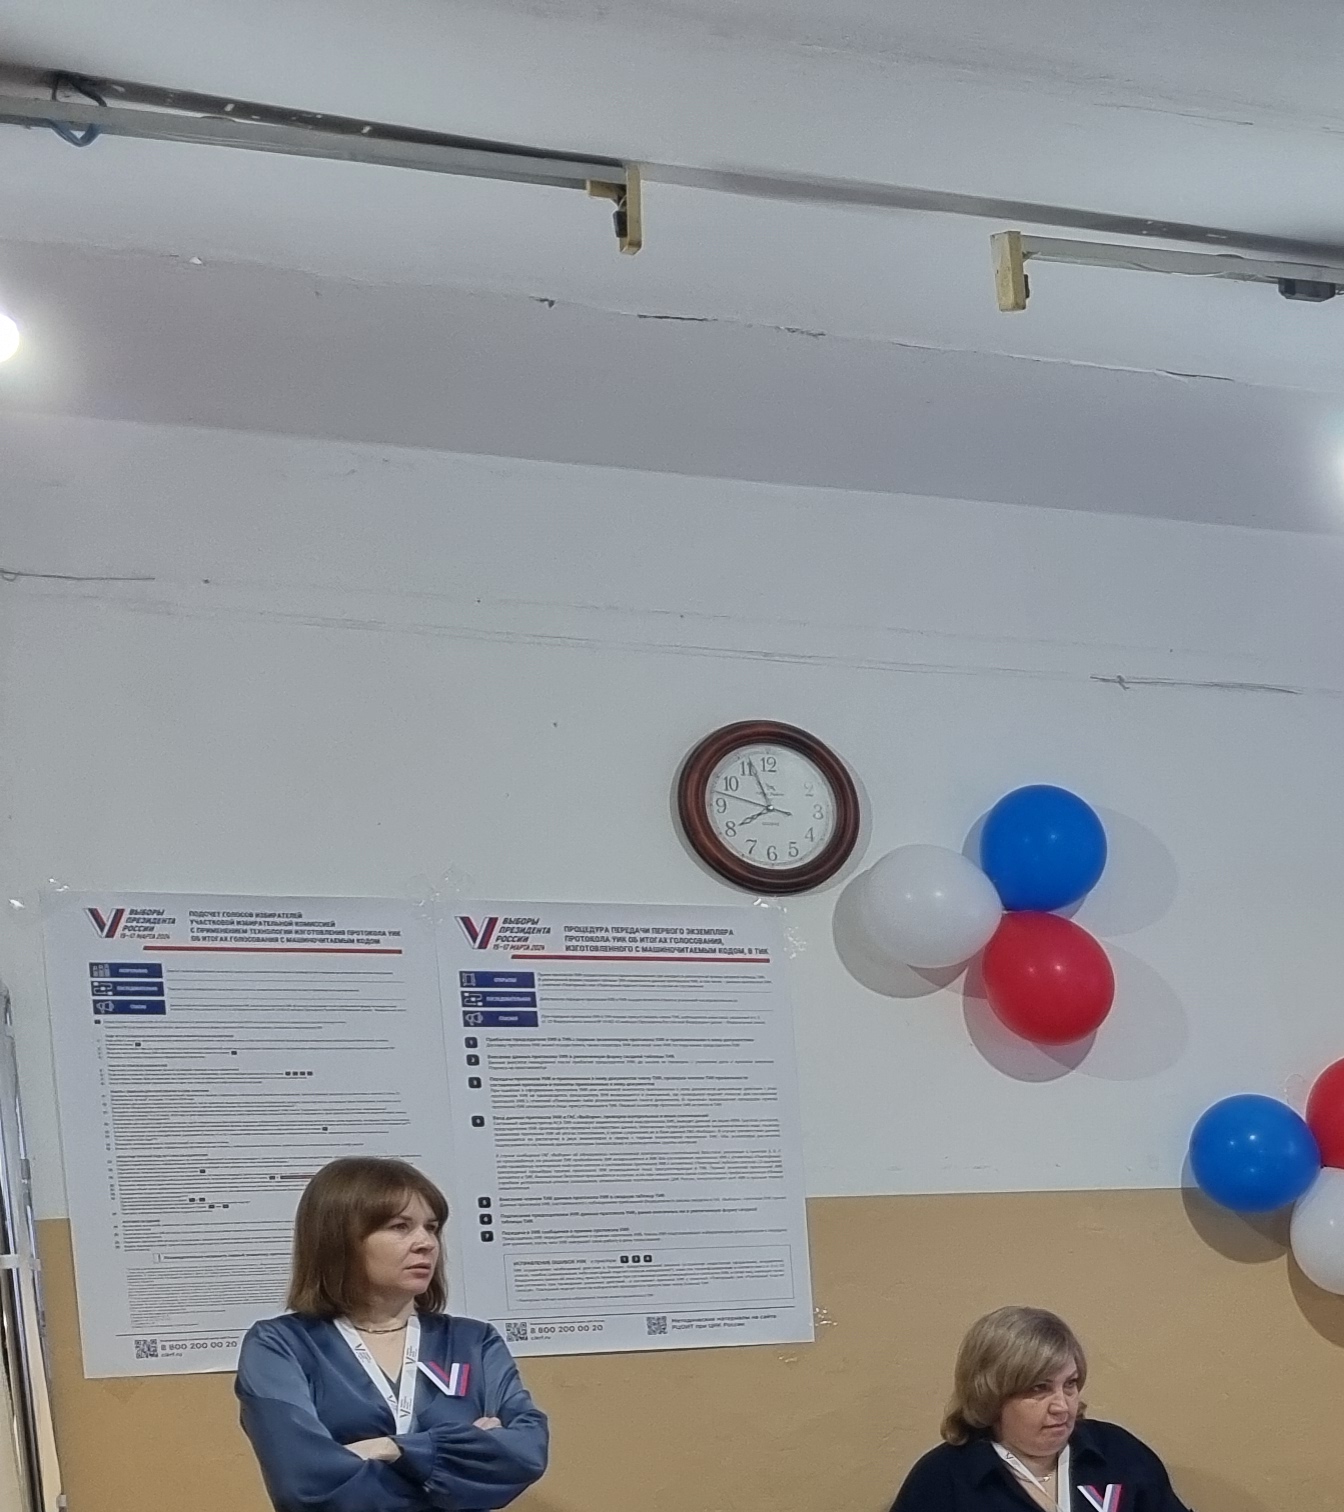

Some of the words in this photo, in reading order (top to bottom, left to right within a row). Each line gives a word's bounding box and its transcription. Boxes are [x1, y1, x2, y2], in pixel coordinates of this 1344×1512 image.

[760, 756, 777, 773] 12
[723, 775, 739, 792] 10
[715, 797, 727, 814] 9
[812, 804, 824, 820] 3
[725, 821, 738, 838] 8
[804, 827, 815, 842] 4
[745, 839, 758, 855] 7
[766, 845, 778, 861] 6
[788, 841, 799, 857] 5
[502, 917, 540, 926] ВЫБОРЫ
[498, 926, 551, 935] ПРЕЗИДЕНТА
[495, 935, 529, 943] РОССИИ
[538, 1326, 556, 1334] 800
[558, 1325, 575, 1333] 200
[190, 1342, 208, 1350] 200
[225, 1340, 238, 1348] 20
